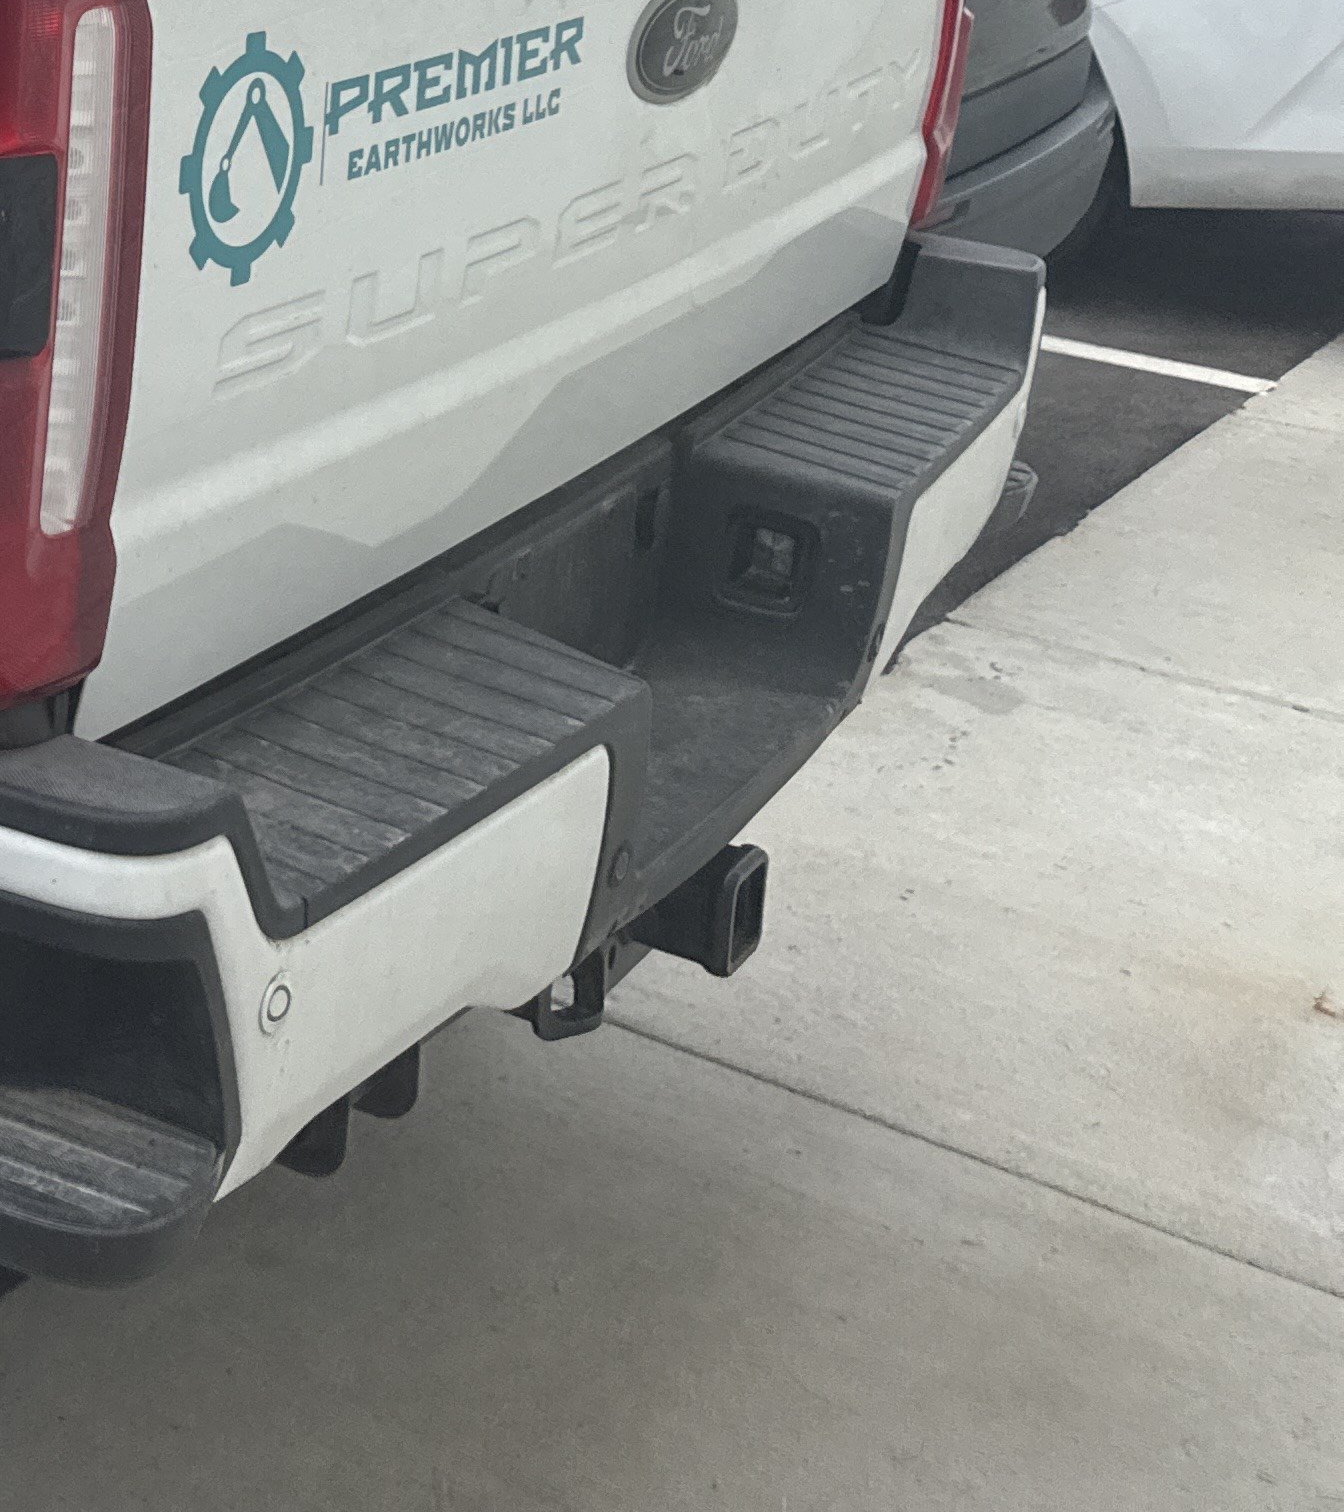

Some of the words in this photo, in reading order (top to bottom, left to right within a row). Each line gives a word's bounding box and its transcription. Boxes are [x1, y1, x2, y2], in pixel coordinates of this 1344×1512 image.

[325, 16, 584, 136] PREMIER
[347, 102, 516, 180] EARTHWORKS
[522, 88, 561, 125] LLC
[214, 152, 698, 398] SUPER
